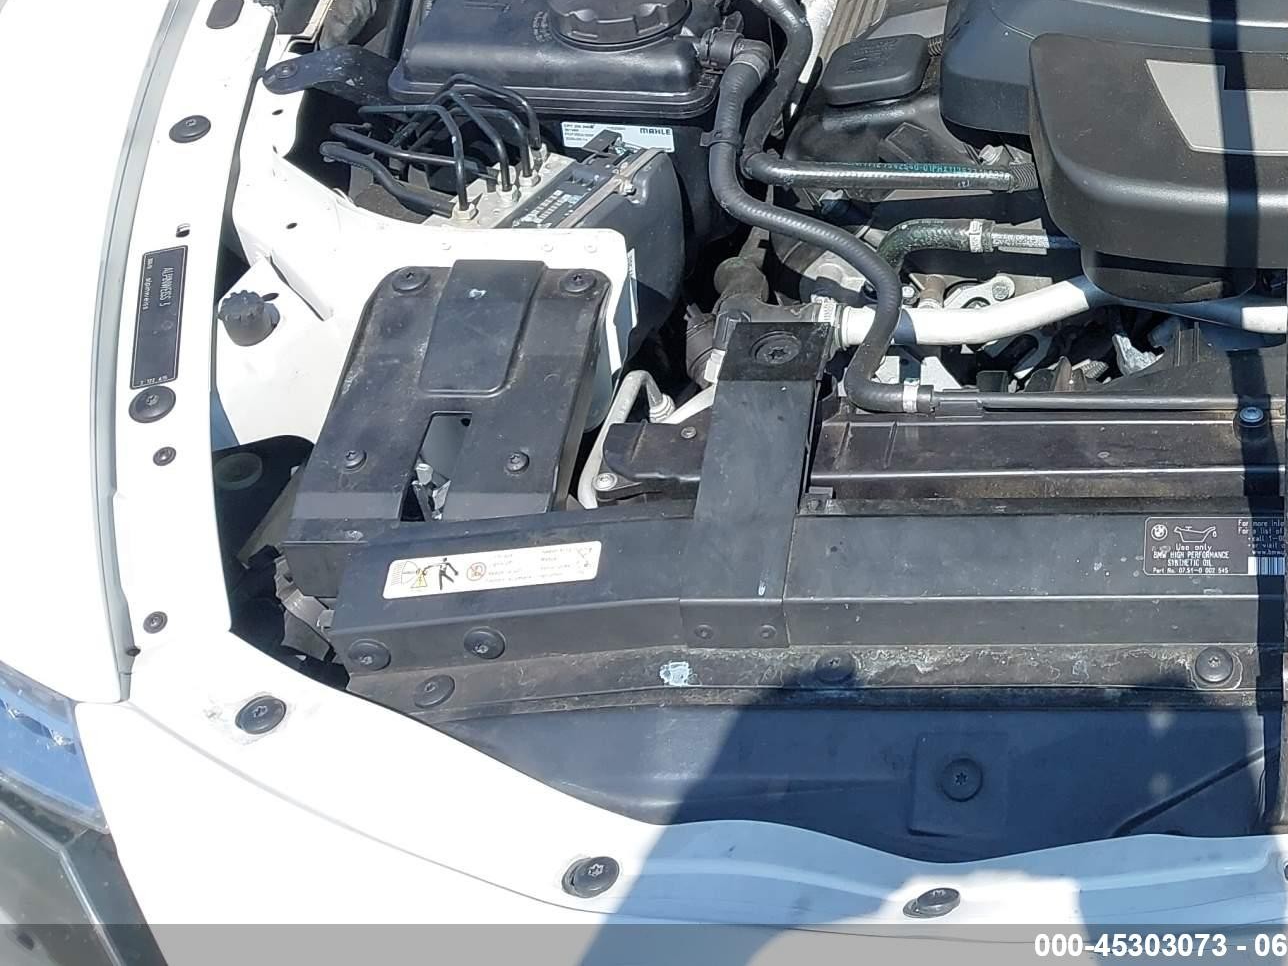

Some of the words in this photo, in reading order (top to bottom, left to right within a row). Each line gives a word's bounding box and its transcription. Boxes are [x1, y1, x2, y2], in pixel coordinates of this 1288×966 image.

[1238, 519, 1249, 527] For
[1238, 526, 1249, 534] For
[1175, 543, 1190, 551] Use
[1194, 543, 1213, 553] only
[1169, 550, 1185, 559] HIGH
[1187, 550, 1230, 559] PERFORMANCE
[1167, 559, 1200, 567] SYNTHETIC
[1202, 559, 1213, 567] OIL
